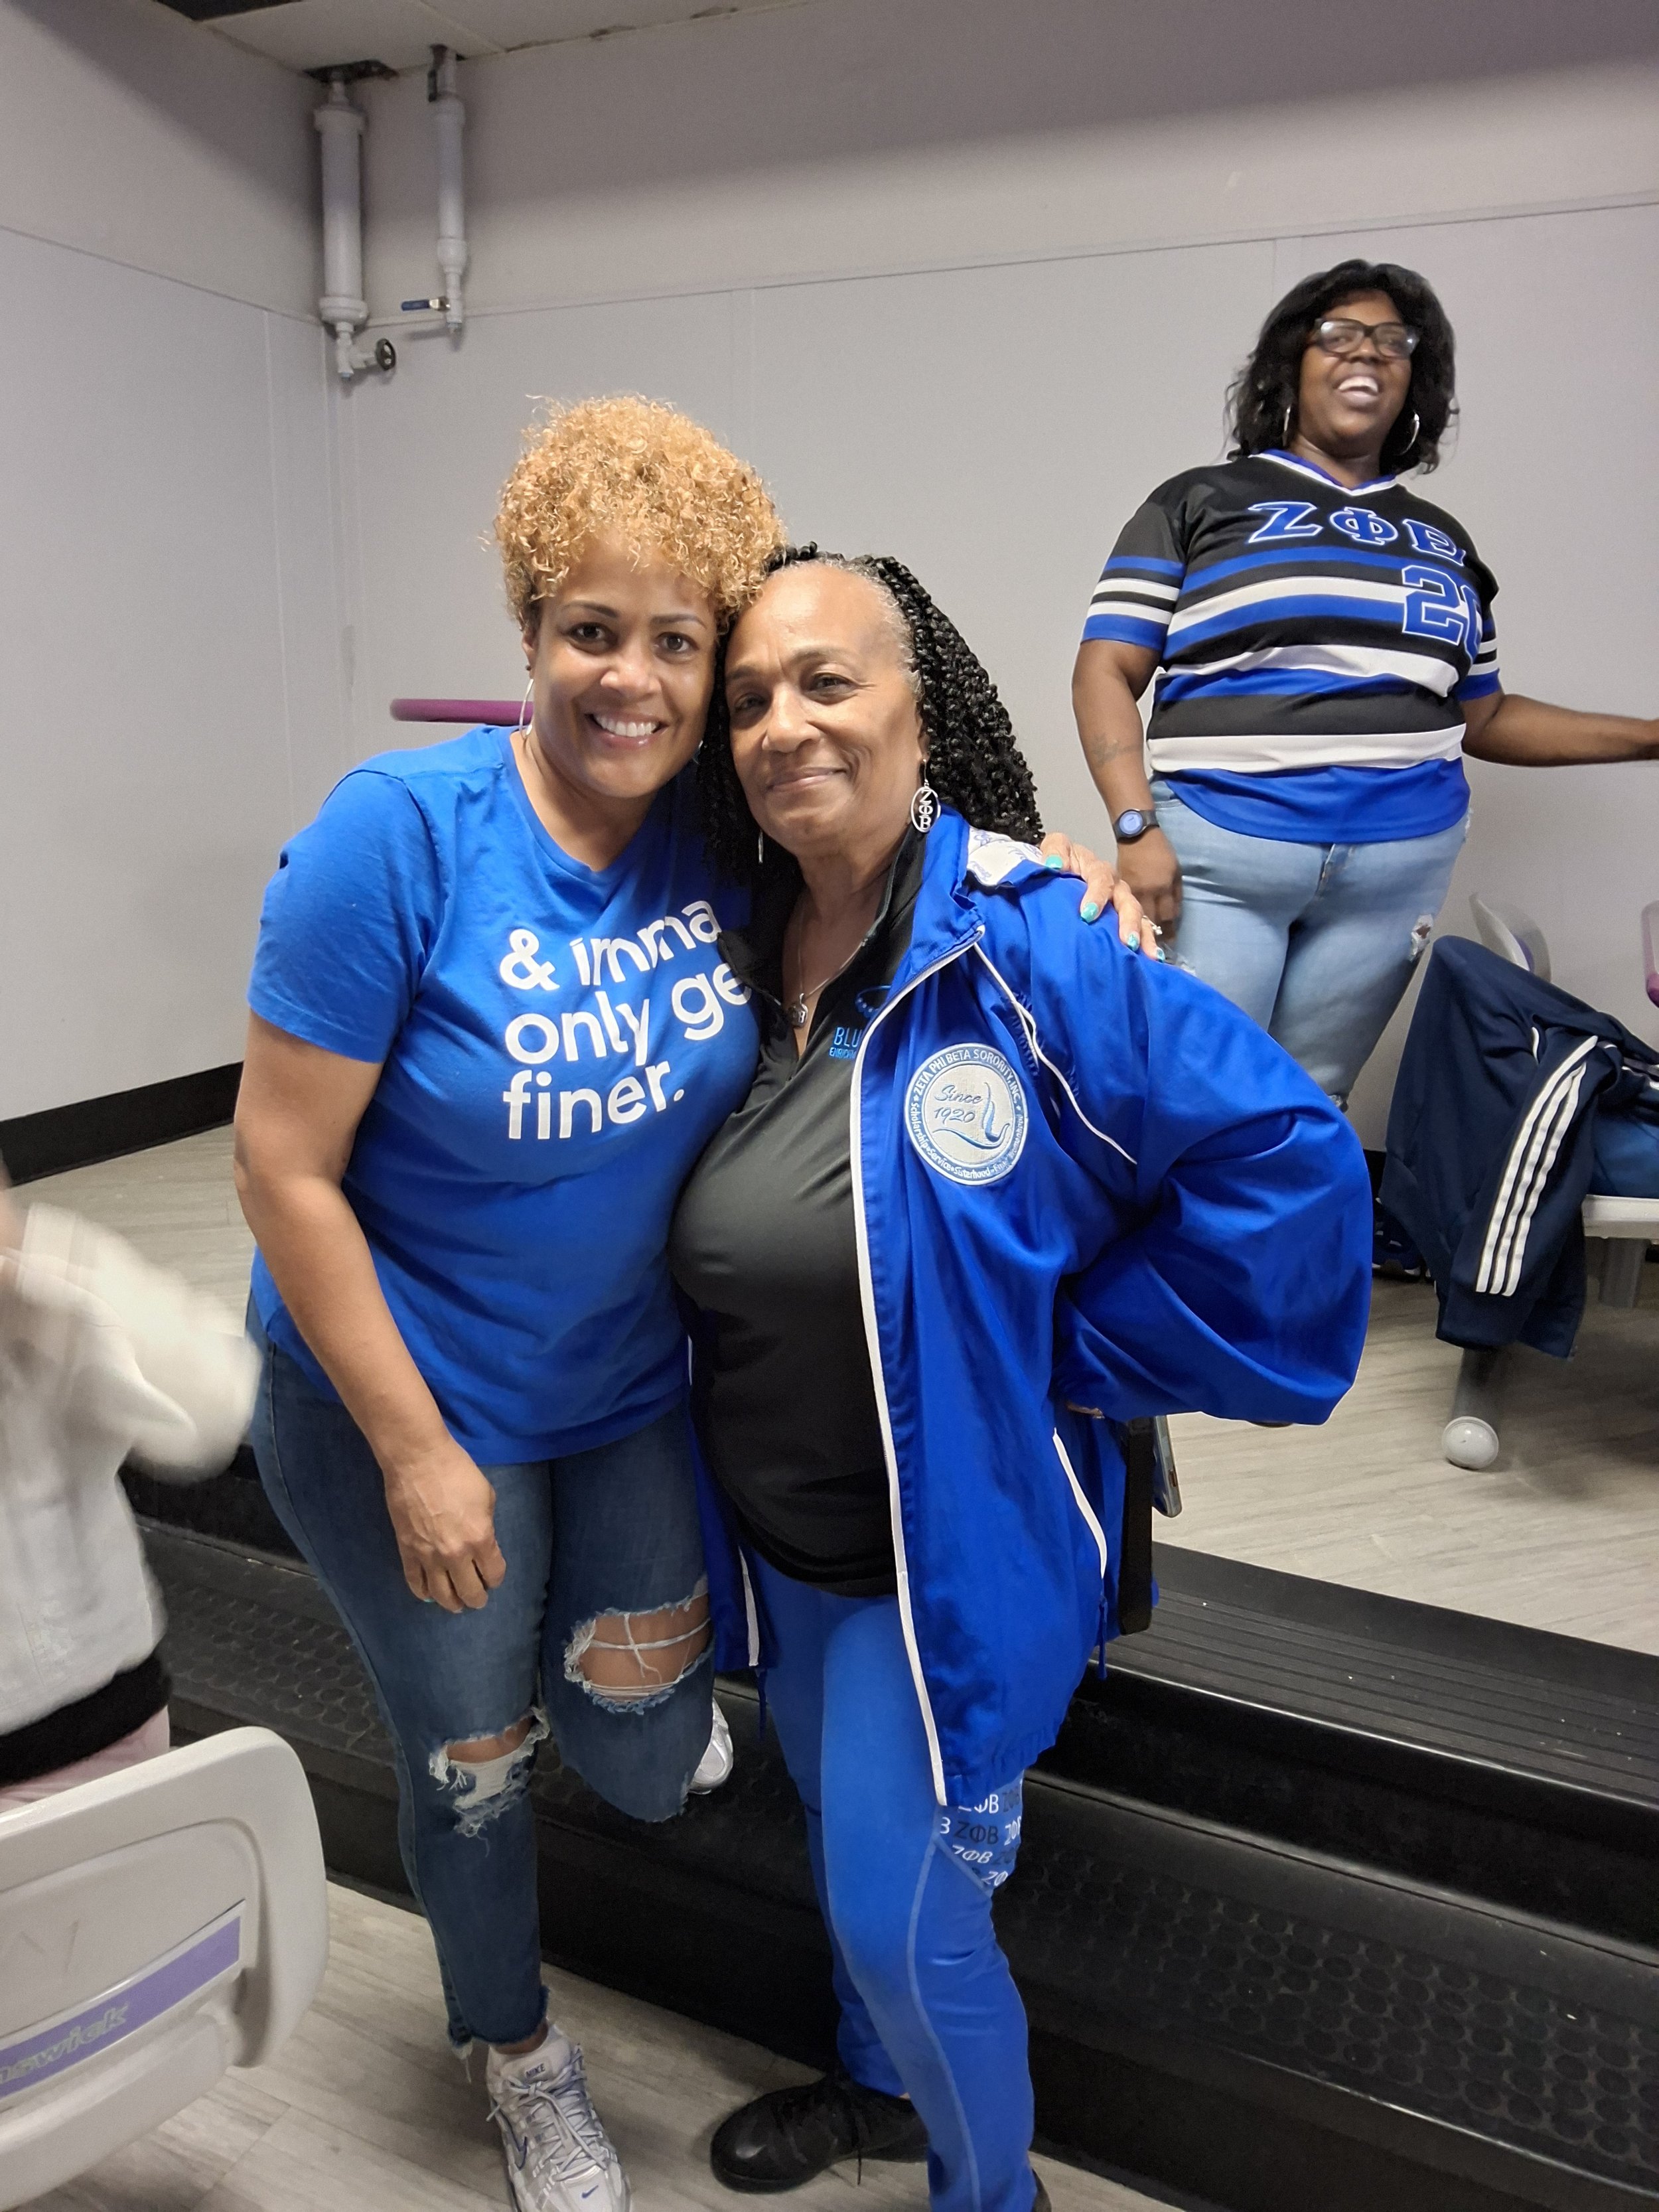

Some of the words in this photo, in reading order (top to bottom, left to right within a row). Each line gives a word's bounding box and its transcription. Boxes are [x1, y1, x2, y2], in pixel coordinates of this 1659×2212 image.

[499, 928, 559, 992] &
[569, 900, 722, 986] imma
[505, 991, 650, 1067] only
[502, 1061, 685, 1140] finer.
[913, 1070, 934, 1096] ZETA
[928, 1056, 947, 1073] PHI
[945, 1049, 971, 1064] BETA
[934, 1084, 983, 1104] Since
[934, 1107, 976, 1125] 1920
